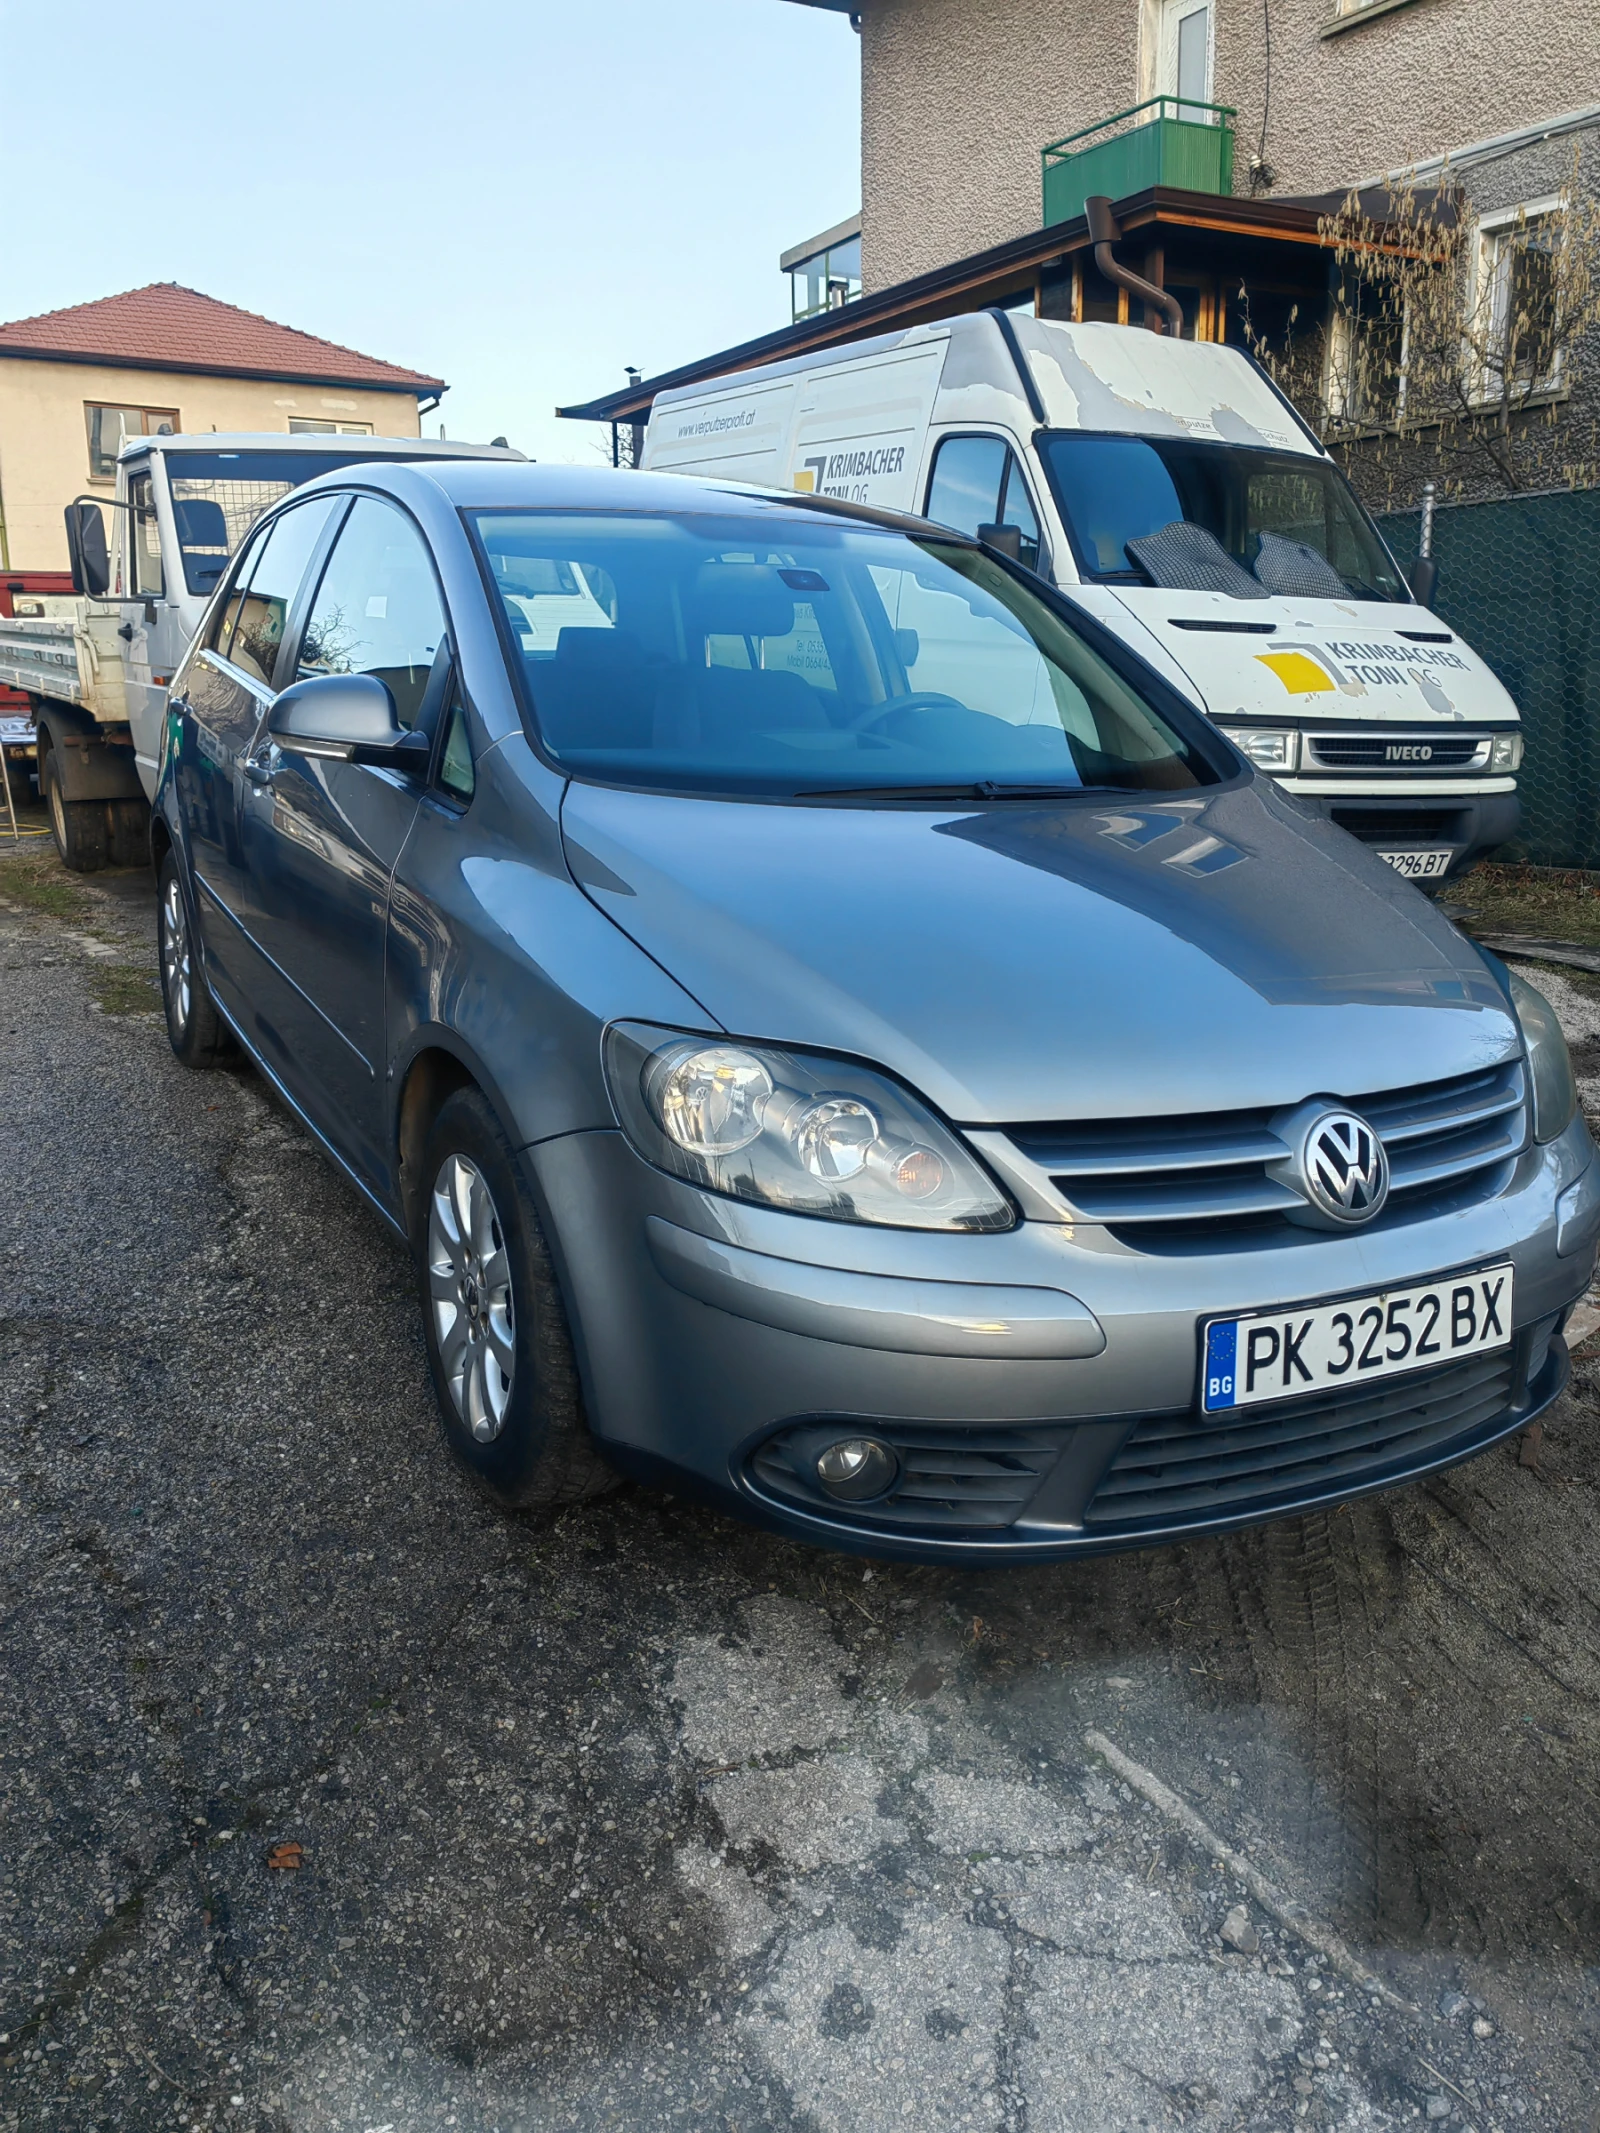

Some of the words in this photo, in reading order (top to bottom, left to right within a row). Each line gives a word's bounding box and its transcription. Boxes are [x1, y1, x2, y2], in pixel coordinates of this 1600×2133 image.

[827, 446, 905, 479] KRIMBACHER
[851, 483, 869, 503] OG
[1325, 642, 1471, 672] KRIMBACHER
[1344, 665, 1408, 686] TONI
[1407, 667, 1442, 688] OG
[1385, 746, 1433, 760] IVECO
[1423, 854, 1449, 874] BT
[1308, 1115, 1386, 1214] VW
[1245, 1318, 1314, 1393] PK
[1327, 1293, 1441, 1376] 3252
[1451, 1276, 1505, 1349] BX
[1209, 1375, 1233, 1397] BG
